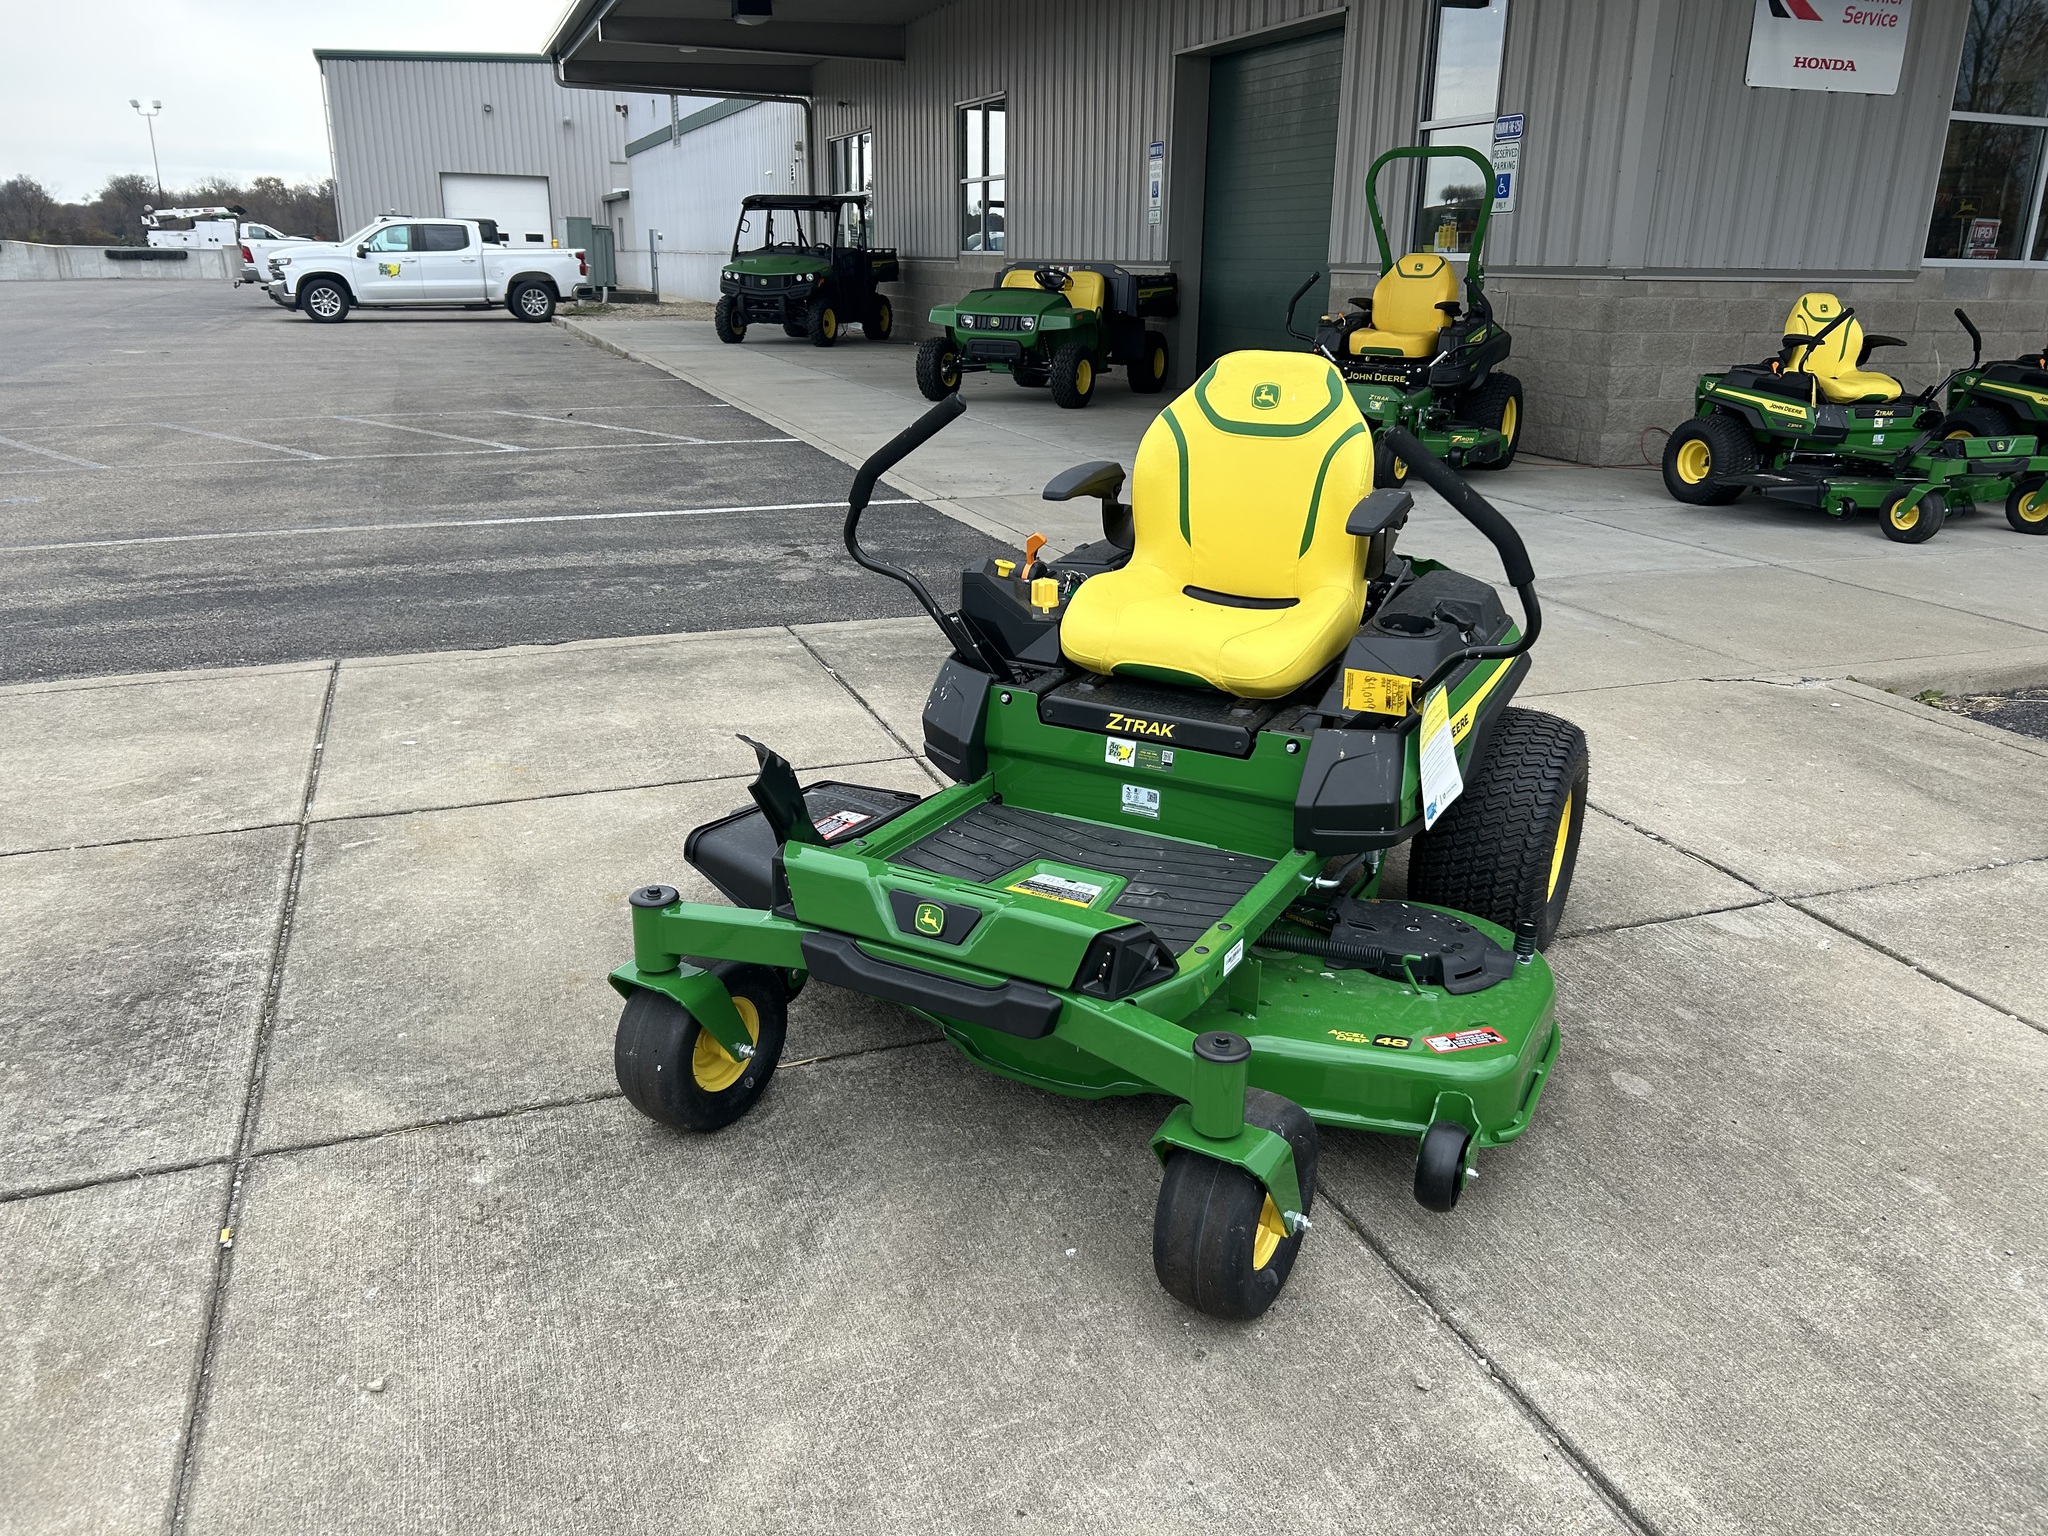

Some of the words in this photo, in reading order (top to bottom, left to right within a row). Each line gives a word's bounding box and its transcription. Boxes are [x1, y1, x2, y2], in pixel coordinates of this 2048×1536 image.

[1842, 5, 1899, 28] Service
[1793, 56, 1857, 72] HONDA
[1494, 148, 1518, 159] RESERVED
[1494, 160, 1516, 171] PARKING
[1974, 227, 1993, 239] OPEN
[1347, 371, 1373, 381] JOHN
[1374, 373, 1406, 383] DEERE
[1784, 406, 1803, 415] DEERE
[1361, 675, 1378, 710] $4,099
[1105, 712, 1176, 738] ZTRAK
[1451, 713, 1469, 738] EERE
[1108, 749, 1122, 758] Pro
[1327, 1029, 1367, 1039] ACCEL
[1335, 1035, 1370, 1044] DEEP
[1375, 1037, 1409, 1047] 48
